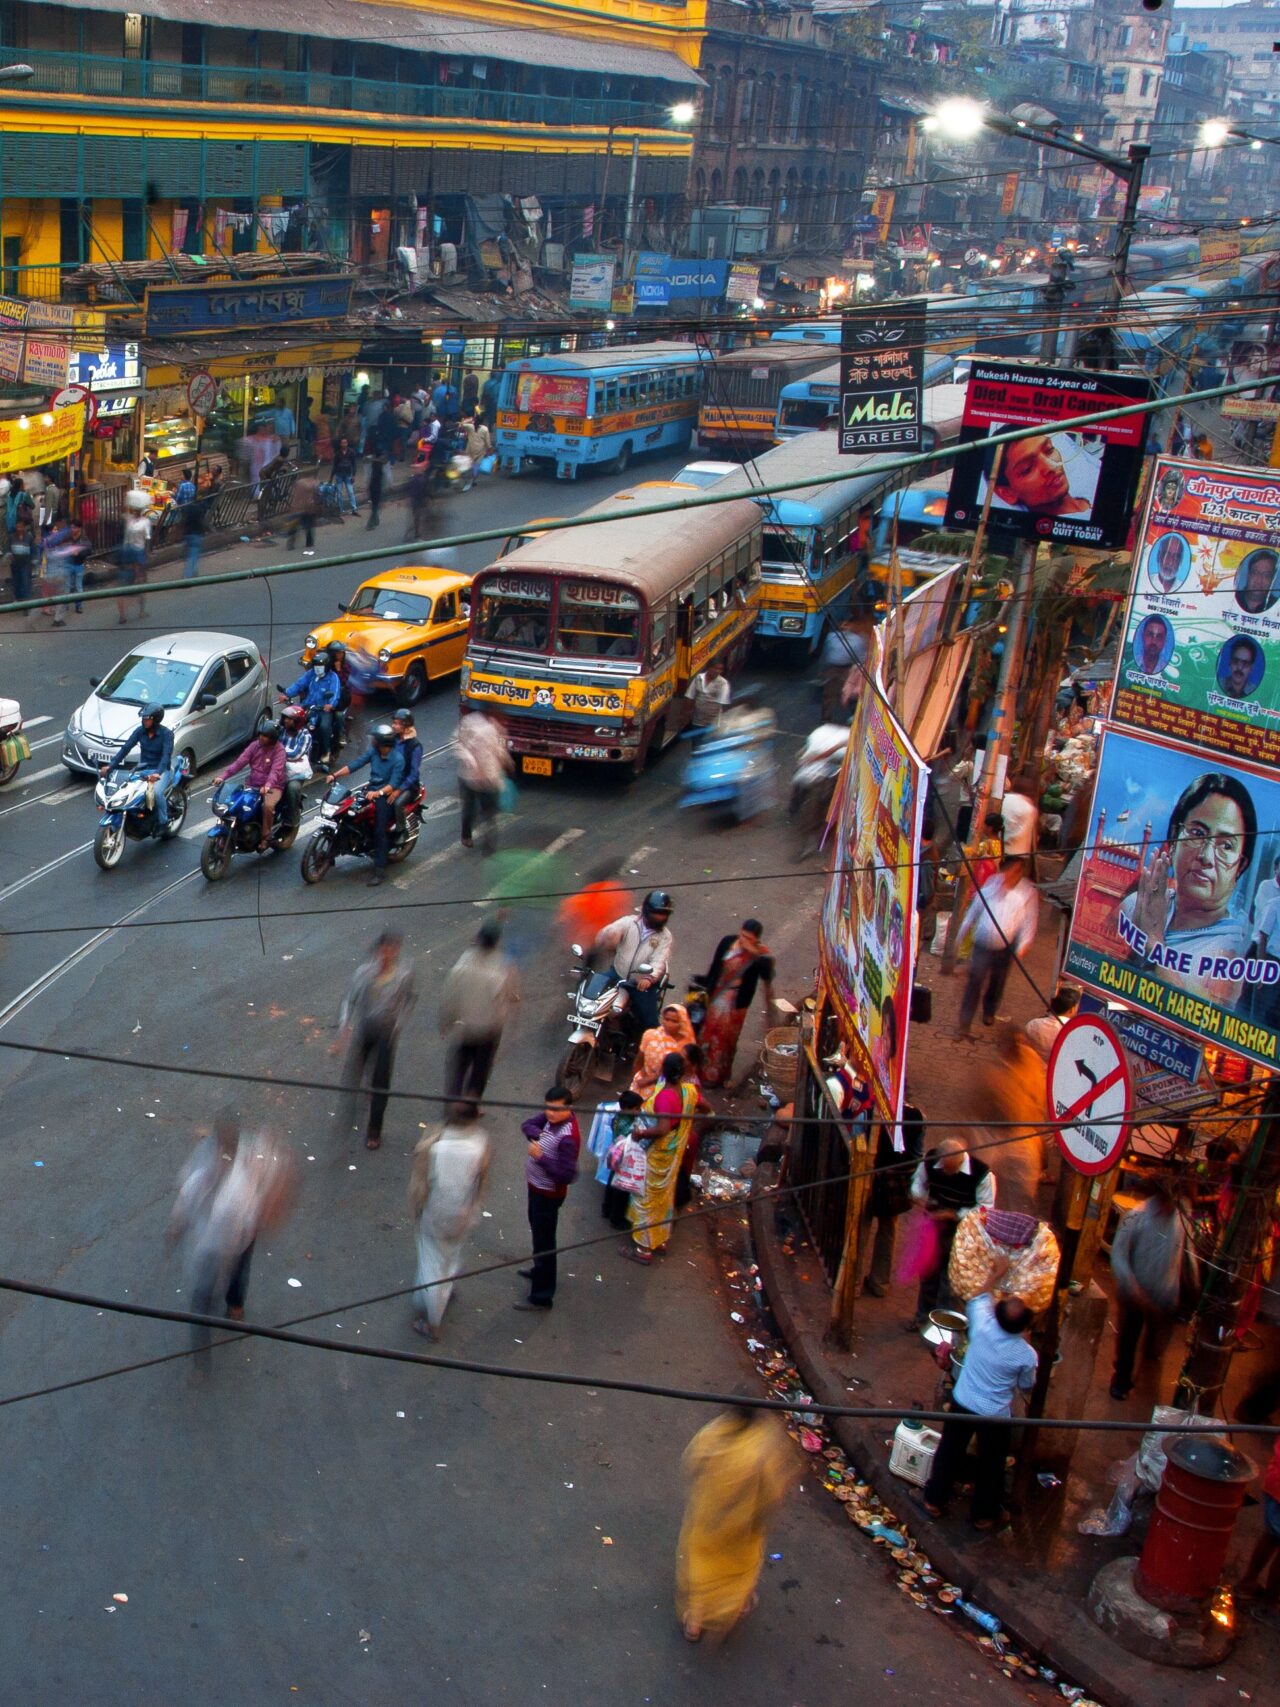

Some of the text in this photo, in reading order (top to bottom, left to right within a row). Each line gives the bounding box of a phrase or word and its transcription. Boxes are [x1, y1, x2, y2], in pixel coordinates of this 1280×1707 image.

[665, 273, 716, 285] NOKIA
[641, 285, 664, 296] NOKIA
[51, 305, 73, 319] TOUCH
[29, 342, 66, 359] Raymond
[853, 356, 870, 365] শুভ
[848, 368, 869, 384] প্রীতি
[871, 371, 878, 380] ও
[976, 369, 1097, 391] Mukesh Harane 24-year old
[974, 385, 1006, 403] Died
[1033, 391, 1064, 409] Oral
[848, 391, 915, 426] Mala
[845, 429, 915, 445] SAREES
[1189, 478, 1234, 500] जौनपुर
[1201, 502, 1260, 523] 123, काटन
[1052, 527, 1103, 541] QUIT TODAY
[1053, 521, 1103, 534] Tobacco Kills
[1240, 614, 1259, 627] कुमार
[561, 691, 605, 713] হাওড়া
[1226, 697, 1244, 711] प्रसाद
[1118, 911, 1280, 985] WE ARE PROUD
[1068, 950, 1277, 1059] Courtesy: RAJIV ROY, HARESH MISHRA
[1098, 1007, 1180, 1054] AVAILABLE AT
[1093, 1034, 1105, 1047] KTP
[1149, 1048, 1192, 1079] STORE
[1094, 1133, 1109, 1157] BUSES
